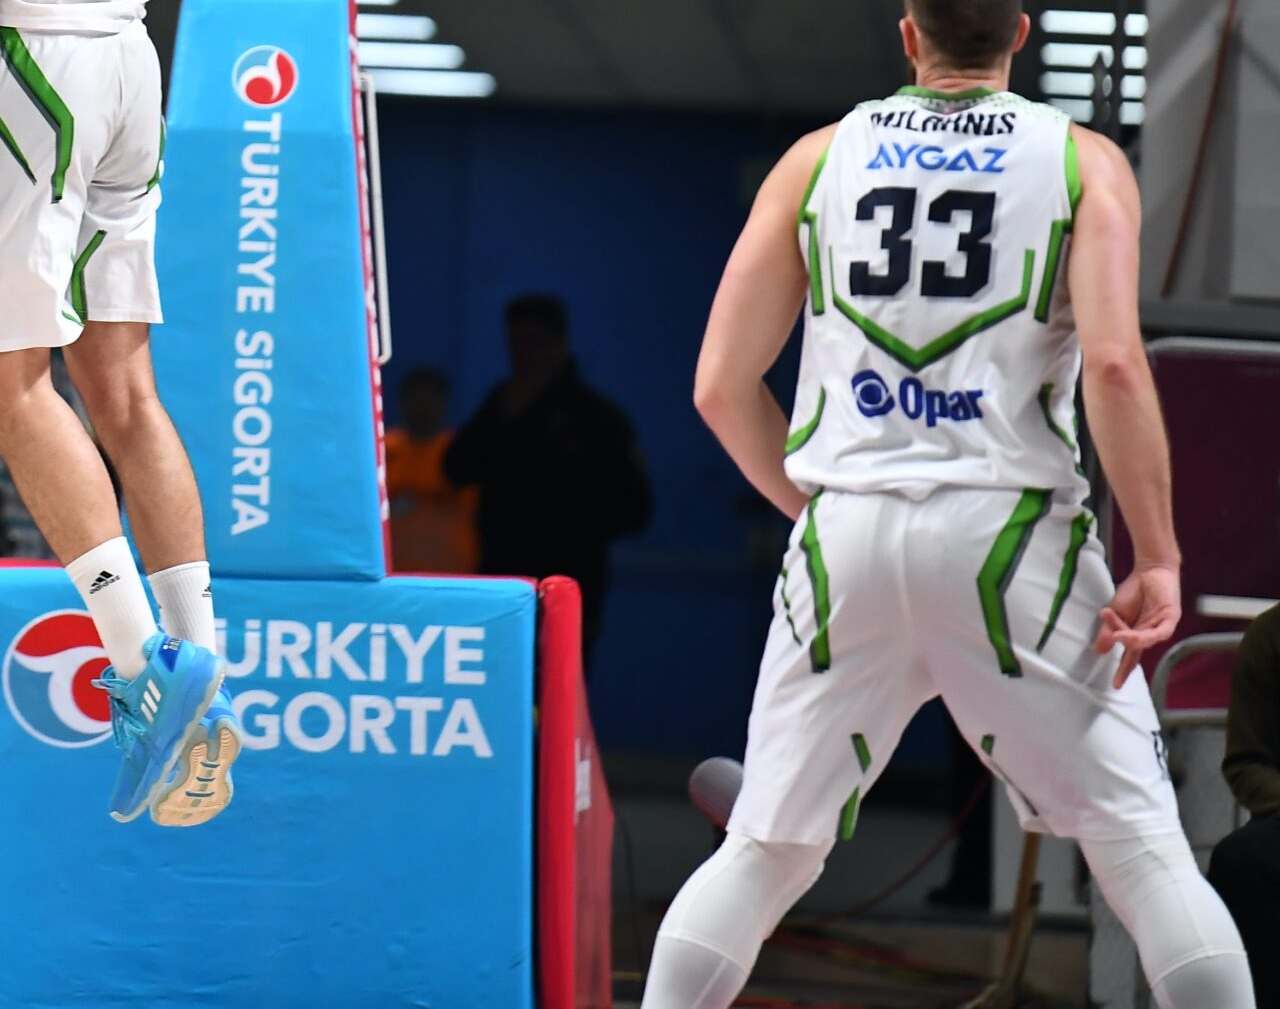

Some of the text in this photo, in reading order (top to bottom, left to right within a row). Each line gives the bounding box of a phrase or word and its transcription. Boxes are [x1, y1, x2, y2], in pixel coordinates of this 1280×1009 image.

[865, 142, 1008, 173] AYGAZ
[849, 186, 997, 298] 33
[899, 376, 984, 428] Opar
[214, 617, 488, 685] ÜRKİYE
[230, 689, 494, 758] GORTA
